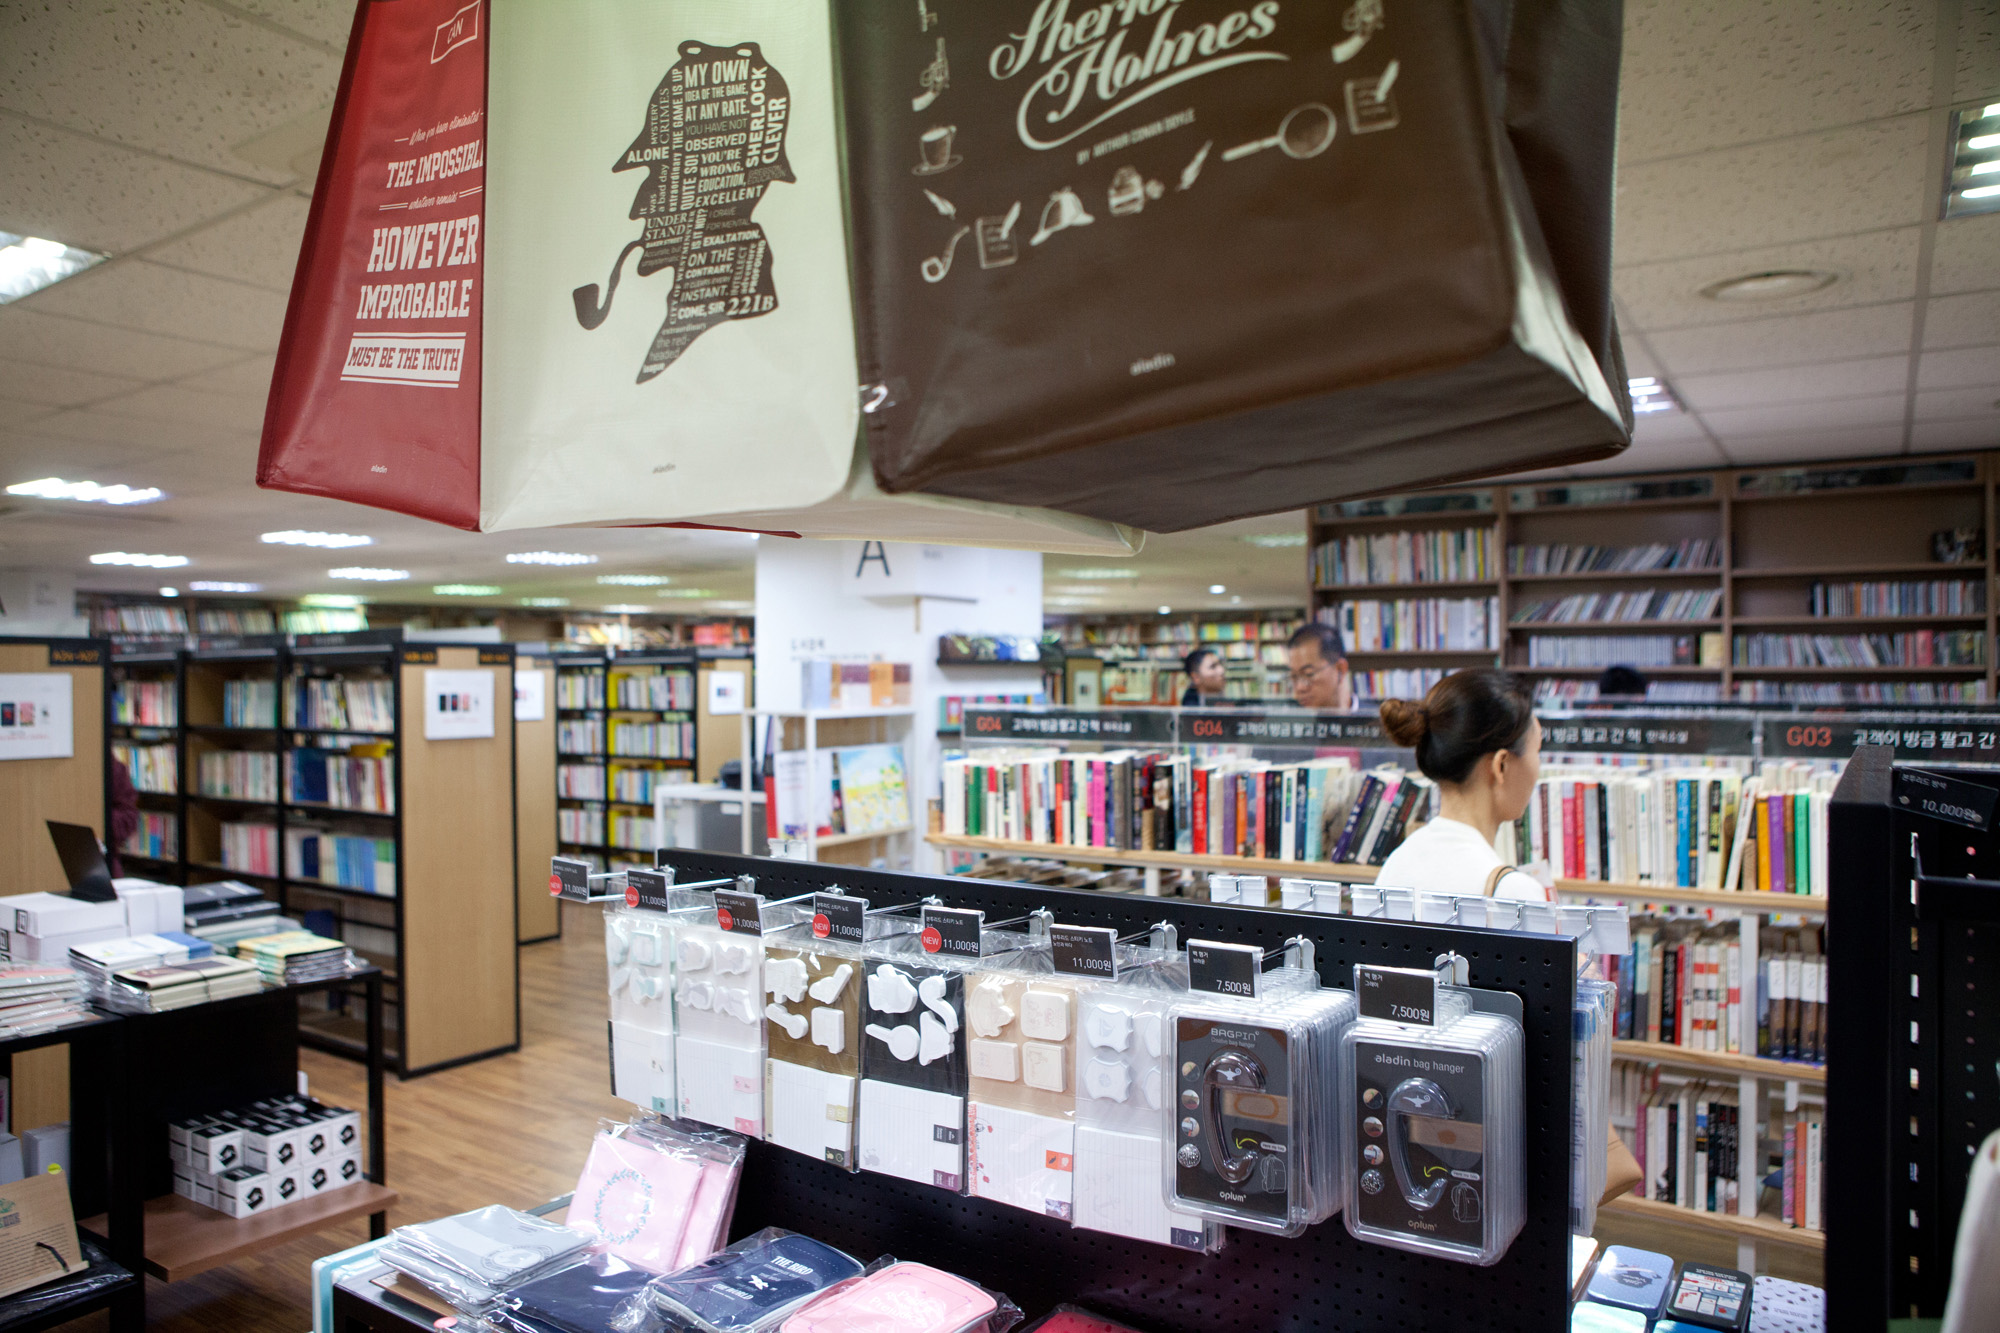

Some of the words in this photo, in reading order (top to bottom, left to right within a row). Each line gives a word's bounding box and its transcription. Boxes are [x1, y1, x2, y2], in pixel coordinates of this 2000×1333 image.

[672, 68, 683, 82] UP
[685, 63, 708, 88] MY
[712, 59, 750, 85] OWN
[1020, 1, 1284, 138] Holmes
[672, 84, 683, 96] IS
[685, 90, 700, 102] IDEA
[701, 88, 711, 100] OF
[711, 86, 725, 98] THE
[659, 87, 670, 144] CRIMES
[672, 98, 684, 128] GAME
[685, 105, 698, 122] AT
[700, 102, 720, 120] ANY
[722, 98, 750, 117] RATE.
[745, 66, 769, 168] SHERLOCK
[650, 103, 659, 145] MYSTERY
[685, 125, 703, 136] YOU
[705, 121, 728, 134] HAVE
[729, 118, 748, 130] NOT
[762, 97, 787, 164] CLEVER
[672, 130, 684, 150] THE
[685, 132, 747, 152] OBSERVED
[627, 146, 670, 164] ALONE
[683, 153, 699, 175] SO!
[701, 148, 743, 164] YOU'RE
[386, 159, 417, 188] THE
[700, 161, 744, 178] WRONG.
[698, 173, 747, 193] EDUCATION,
[680, 177, 697, 211] QUITE
[695, 185, 764, 208] EXCELLENT
[647, 212, 688, 229] UNDER
[645, 224, 686, 241] STAND
[366, 214, 480, 273] HOWEVER
[687, 252, 708, 267] ON
[711, 247, 736, 264] THE
[356, 279, 473, 319] IMPROBABLE
[680, 285, 729, 302] INSTANT.
[726, 294, 774, 316] 221B
[348, 347, 380, 367] MUST
[379, 348, 397, 368] BE
[398, 348, 422, 370] THE
[422, 348, 461, 371] TRUTH
[976, 715, 1002, 732] G04
[1193, 719, 1224, 737] G04
[1787, 726, 1832, 748] G03
[1852, 728, 1900, 747] 고객이
[1903, 729, 1937, 748] 방금
[1939, 730, 1974, 749] 팔고
[1978, 731, 1996, 750] 간
[719, 915, 731, 924] NEW
[814, 922, 829, 931] NEW
[831, 924, 862, 938] 11,000원
[923, 935, 940, 946] NEW
[943, 938, 979, 953] 11,000원
[1072, 957, 1112, 972] 11,000원
[1216, 979, 1252, 995] 7,500원
[1390, 1003, 1430, 1022] 7,500원
[1374, 1053, 1411, 1067] aladin
[1413, 1058, 1430, 1071] bag
[1432, 1061, 1465, 1074] hanger
[770, 1255, 793, 1270] THE
[789, 1261, 814, 1276] BIRD
